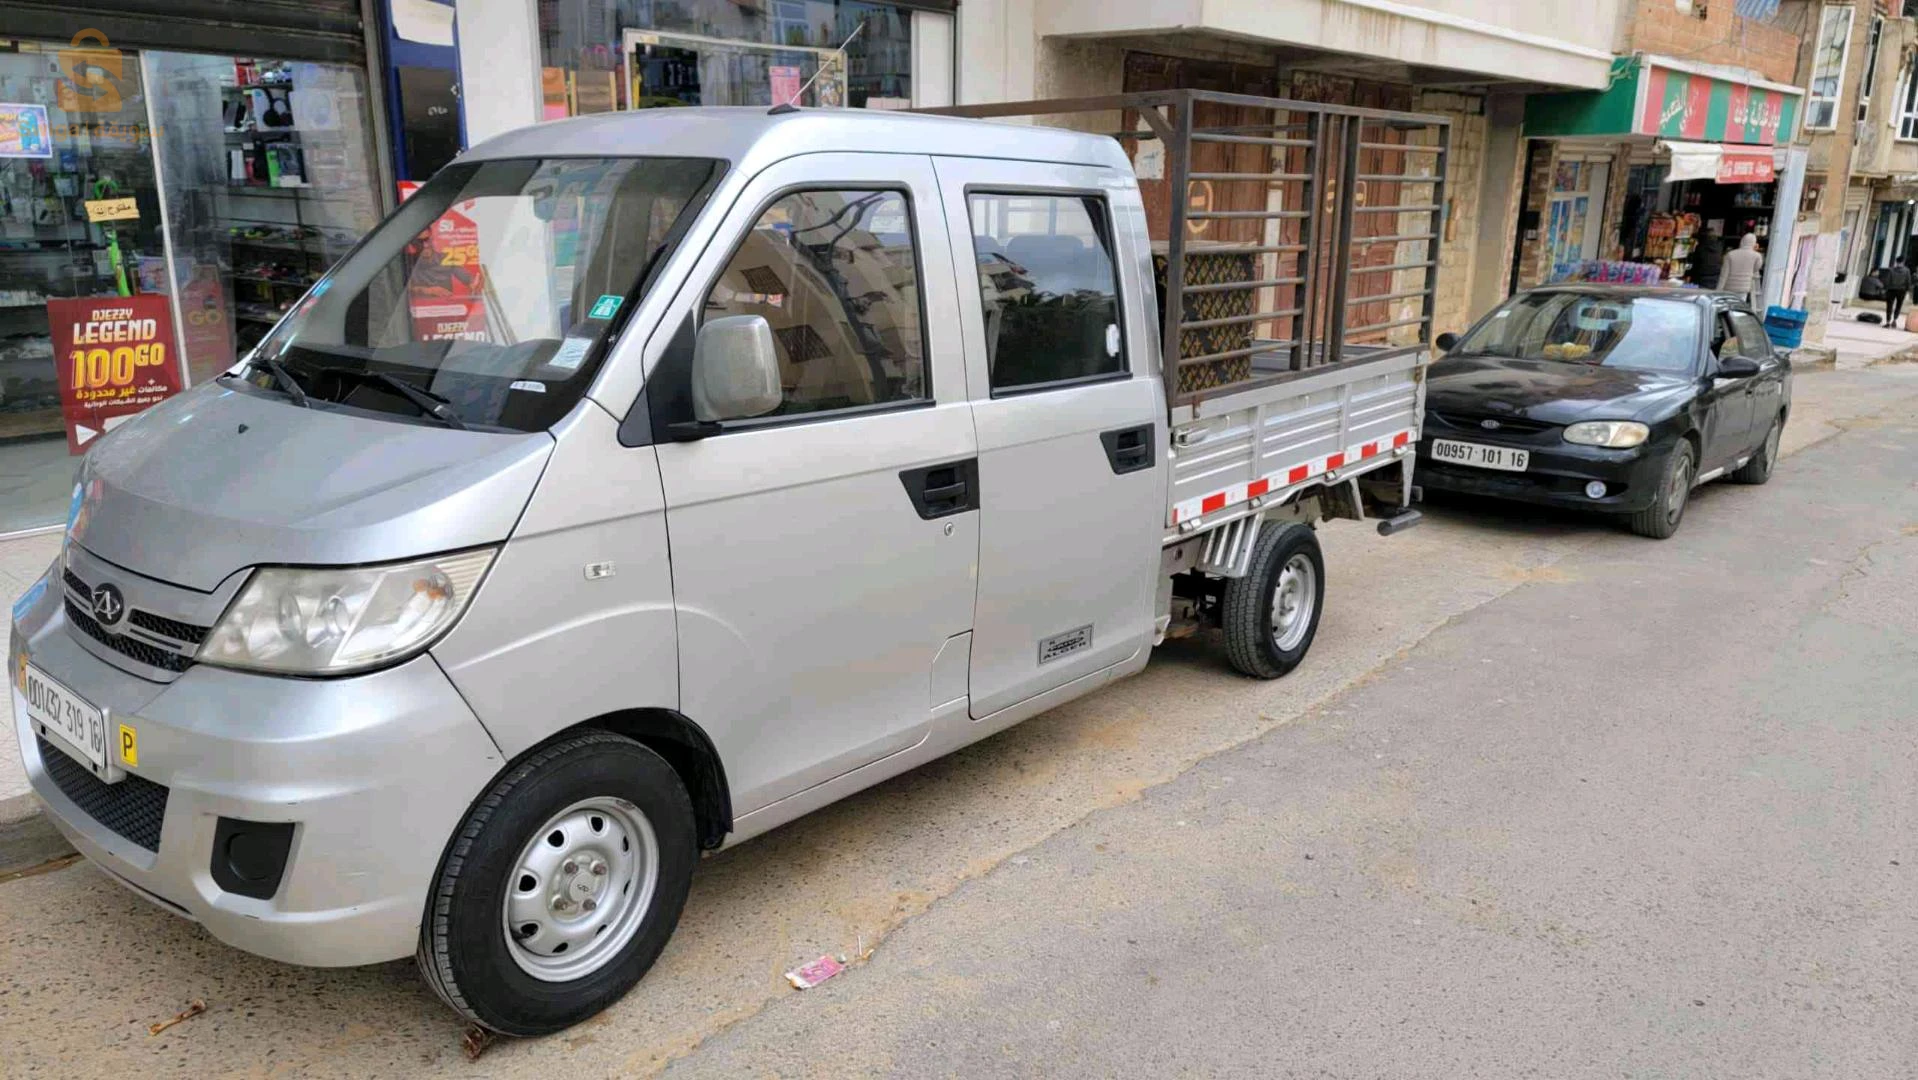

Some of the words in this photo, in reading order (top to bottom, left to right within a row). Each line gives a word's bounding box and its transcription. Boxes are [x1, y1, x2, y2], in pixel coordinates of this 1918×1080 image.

[92, 308, 133, 321] DJEZZY
[73, 319, 157, 345] LEGEND
[76, 388, 116, 401] محدودة
[119, 385, 137, 398] غير
[1436, 442, 1473, 460] 00957
[1482, 448, 1502, 465] 101
[1511, 452, 1526, 468] 16
[65, 700, 84, 740] 319
[88, 716, 102, 753] 16
[122, 731, 133, 758] P
